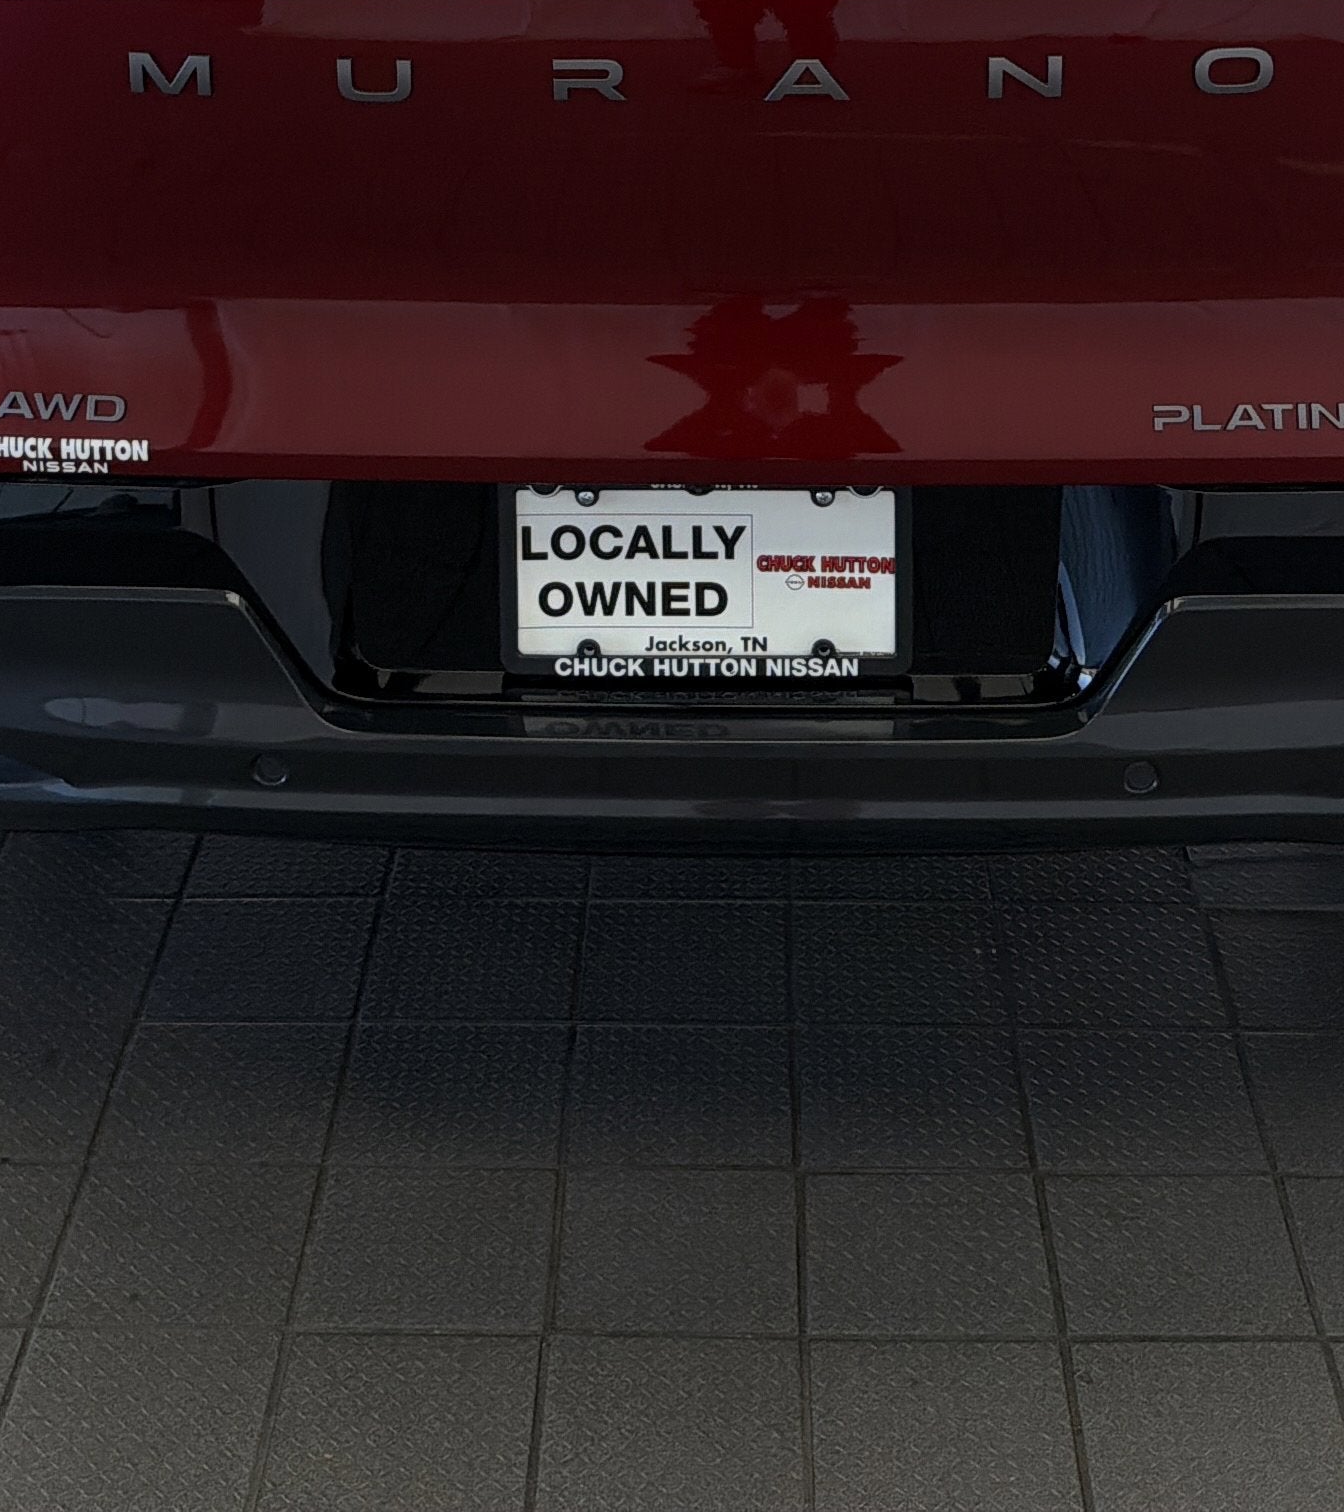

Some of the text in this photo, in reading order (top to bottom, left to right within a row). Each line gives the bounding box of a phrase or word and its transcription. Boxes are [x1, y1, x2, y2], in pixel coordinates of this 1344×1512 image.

[128, 46, 1274, 103] MURANO
[60, 437, 149, 462] HUTTON
[22, 460, 109, 474] NISSAN
[521, 524, 747, 561] LOCALLY
[756, 554, 896, 575] CHUCK HUTTON
[807, 575, 872, 590] NISSAN
[538, 581, 729, 617] OWNED
[645, 635, 768, 655] Jackson, TN
[554, 657, 859, 677] CHUCK HUTTON NISSAN
